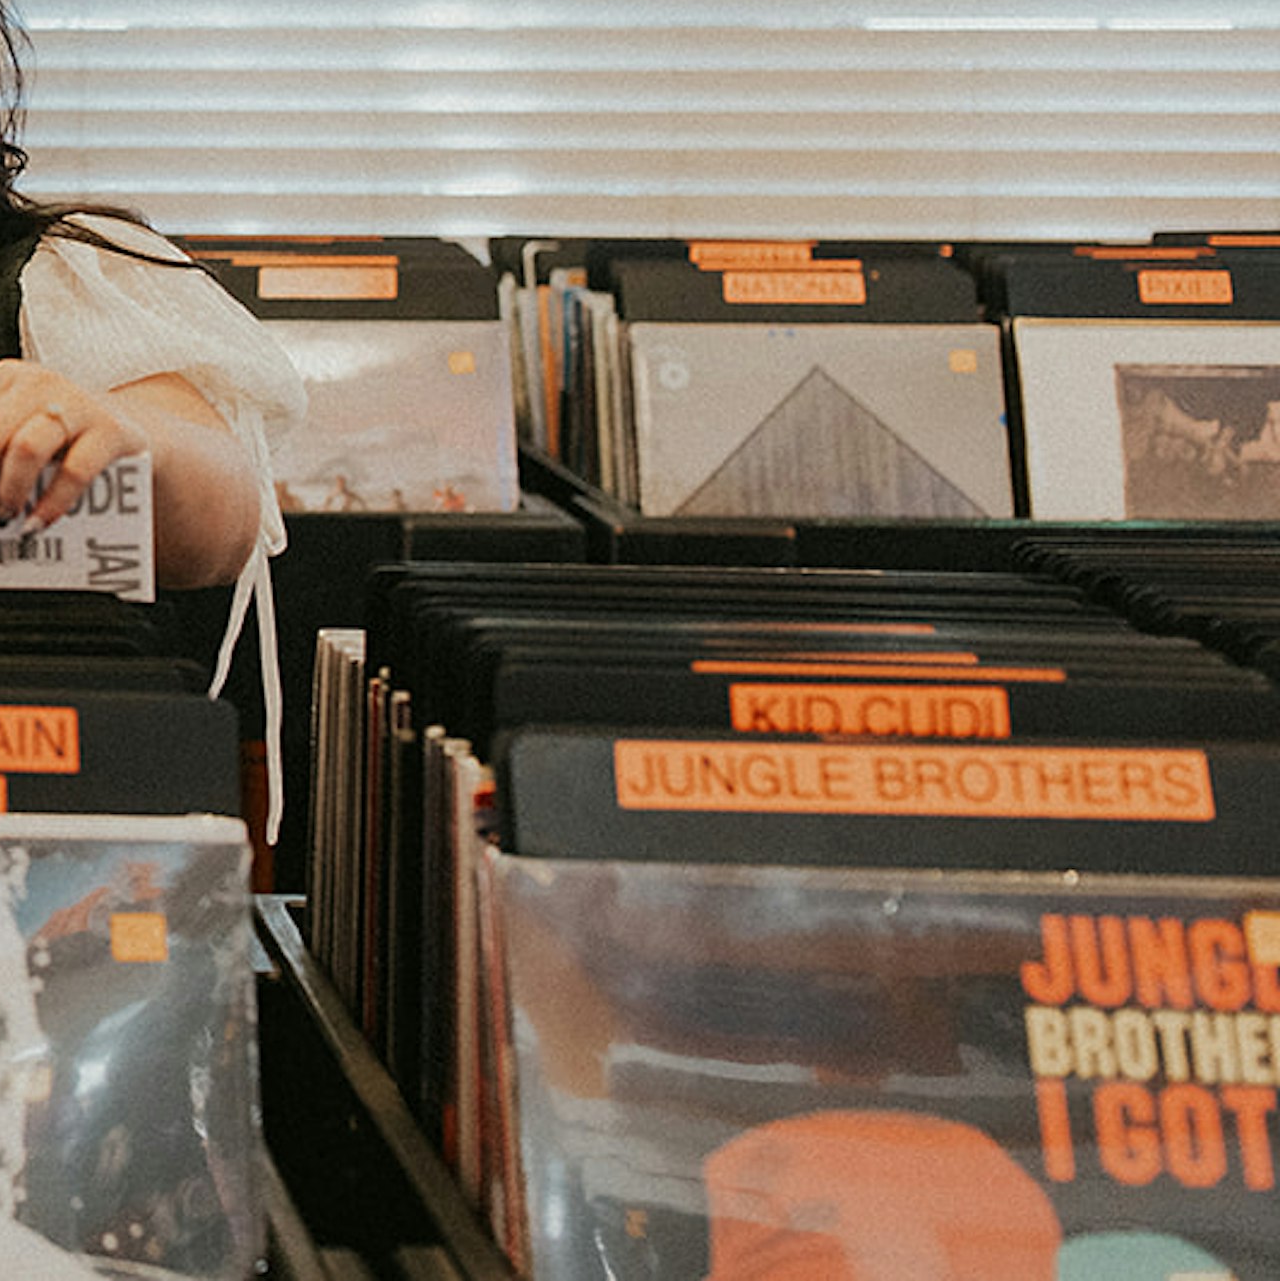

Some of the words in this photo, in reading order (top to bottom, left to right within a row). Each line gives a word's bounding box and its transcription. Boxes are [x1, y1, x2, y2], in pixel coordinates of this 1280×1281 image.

[747, 694, 840, 734] KID
[857, 695, 996, 737] CUDI
[625, 754, 854, 801] JUNGLE
[873, 756, 1201, 808] BROTHERS
[1036, 1076, 1075, 1183] I
[1092, 1081, 1277, 1192] GOT
